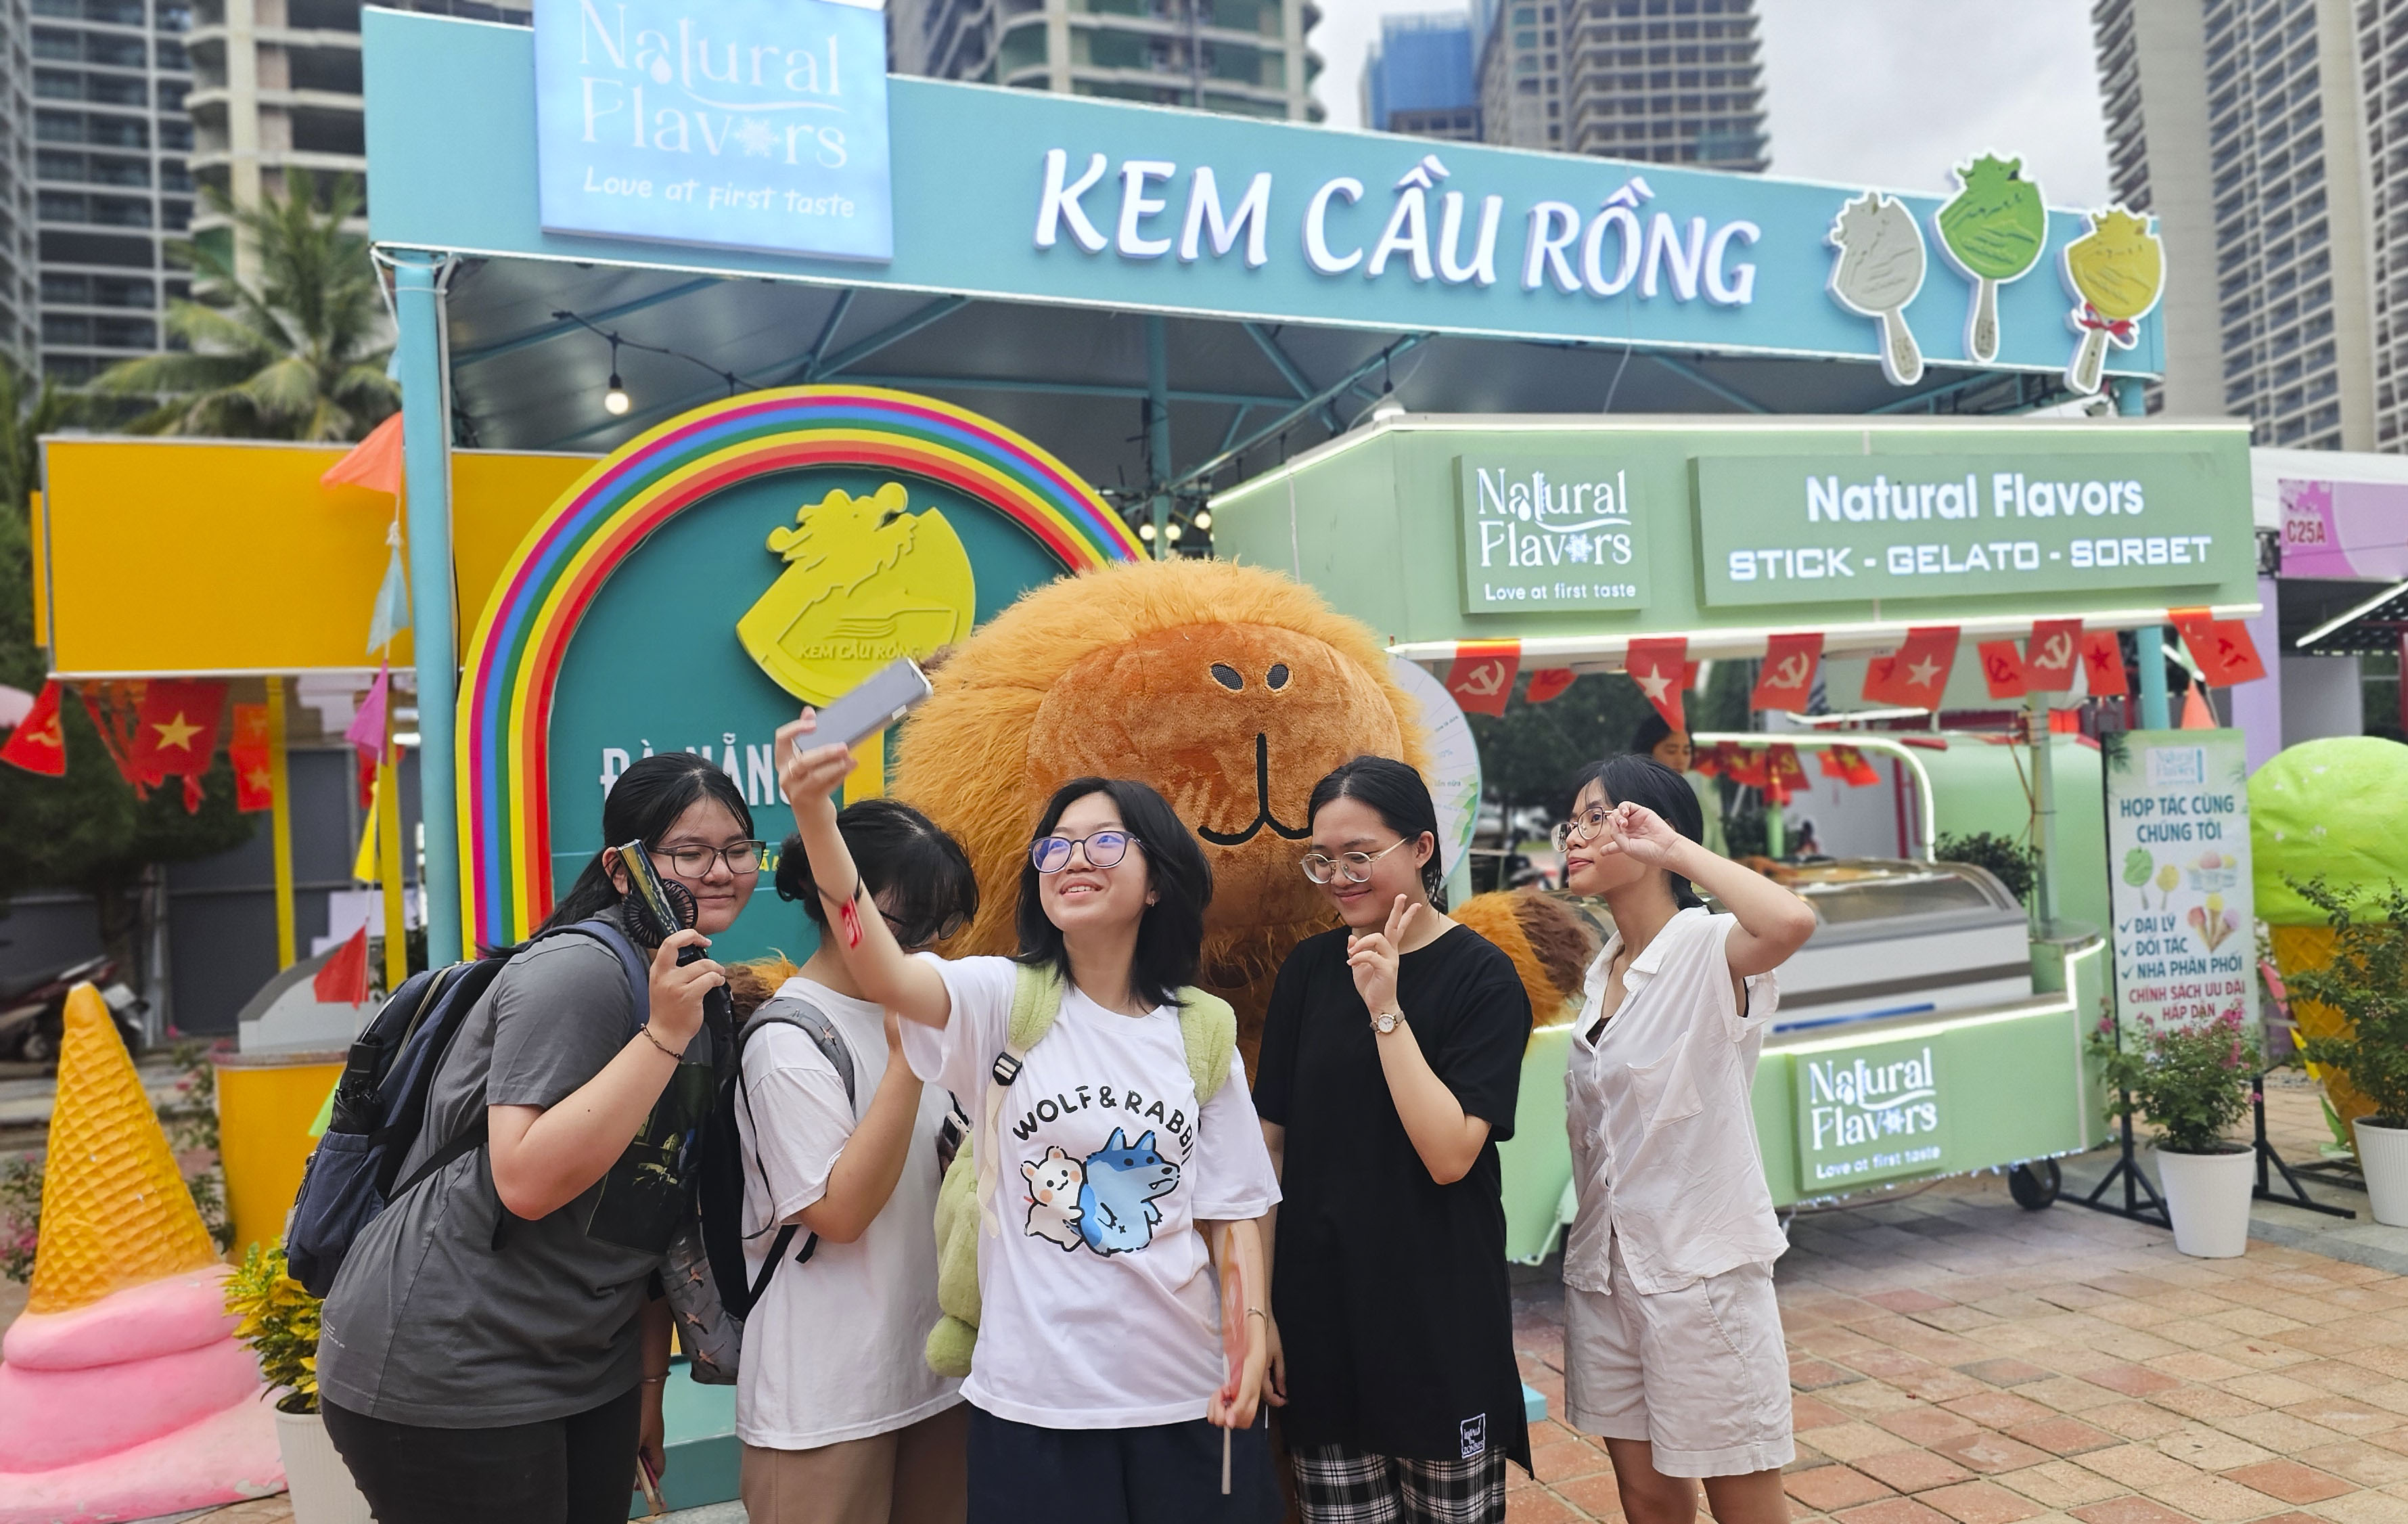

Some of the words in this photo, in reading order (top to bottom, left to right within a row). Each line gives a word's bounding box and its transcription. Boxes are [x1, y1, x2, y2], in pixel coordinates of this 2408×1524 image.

[578, 0, 841, 96] Natural
[583, 166, 654, 198] Love
[665, 178, 700, 202] at
[784, 189, 855, 218] taste
[1033, 149, 1273, 268] KEM
[1302, 154, 1503, 288] CẦU
[1521, 176, 1760, 307] RỒNG
[1476, 468, 1628, 521] Natural
[1806, 473, 1979, 522] Natural
[1993, 472, 2144, 518] Flavors
[2286, 520, 2326, 543] C25A
[1729, 547, 1855, 581] STICK
[1887, 541, 2039, 575] GELATO
[2070, 536, 2212, 567] SORBET
[1484, 584, 1526, 601] Love
[1530, 585, 1547, 600] at
[1554, 583, 1587, 599] first
[1594, 583, 1636, 598] taste
[800, 643, 835, 660] KEM
[2196, 817, 2222, 841] TÔI
[1809, 1047, 1933, 1106] Natural
[1816, 1161, 1850, 1179] Love
[1854, 1158, 1868, 1171] at
[1873, 1152, 1901, 1168] first
[1905, 1146, 1941, 1164] taste
